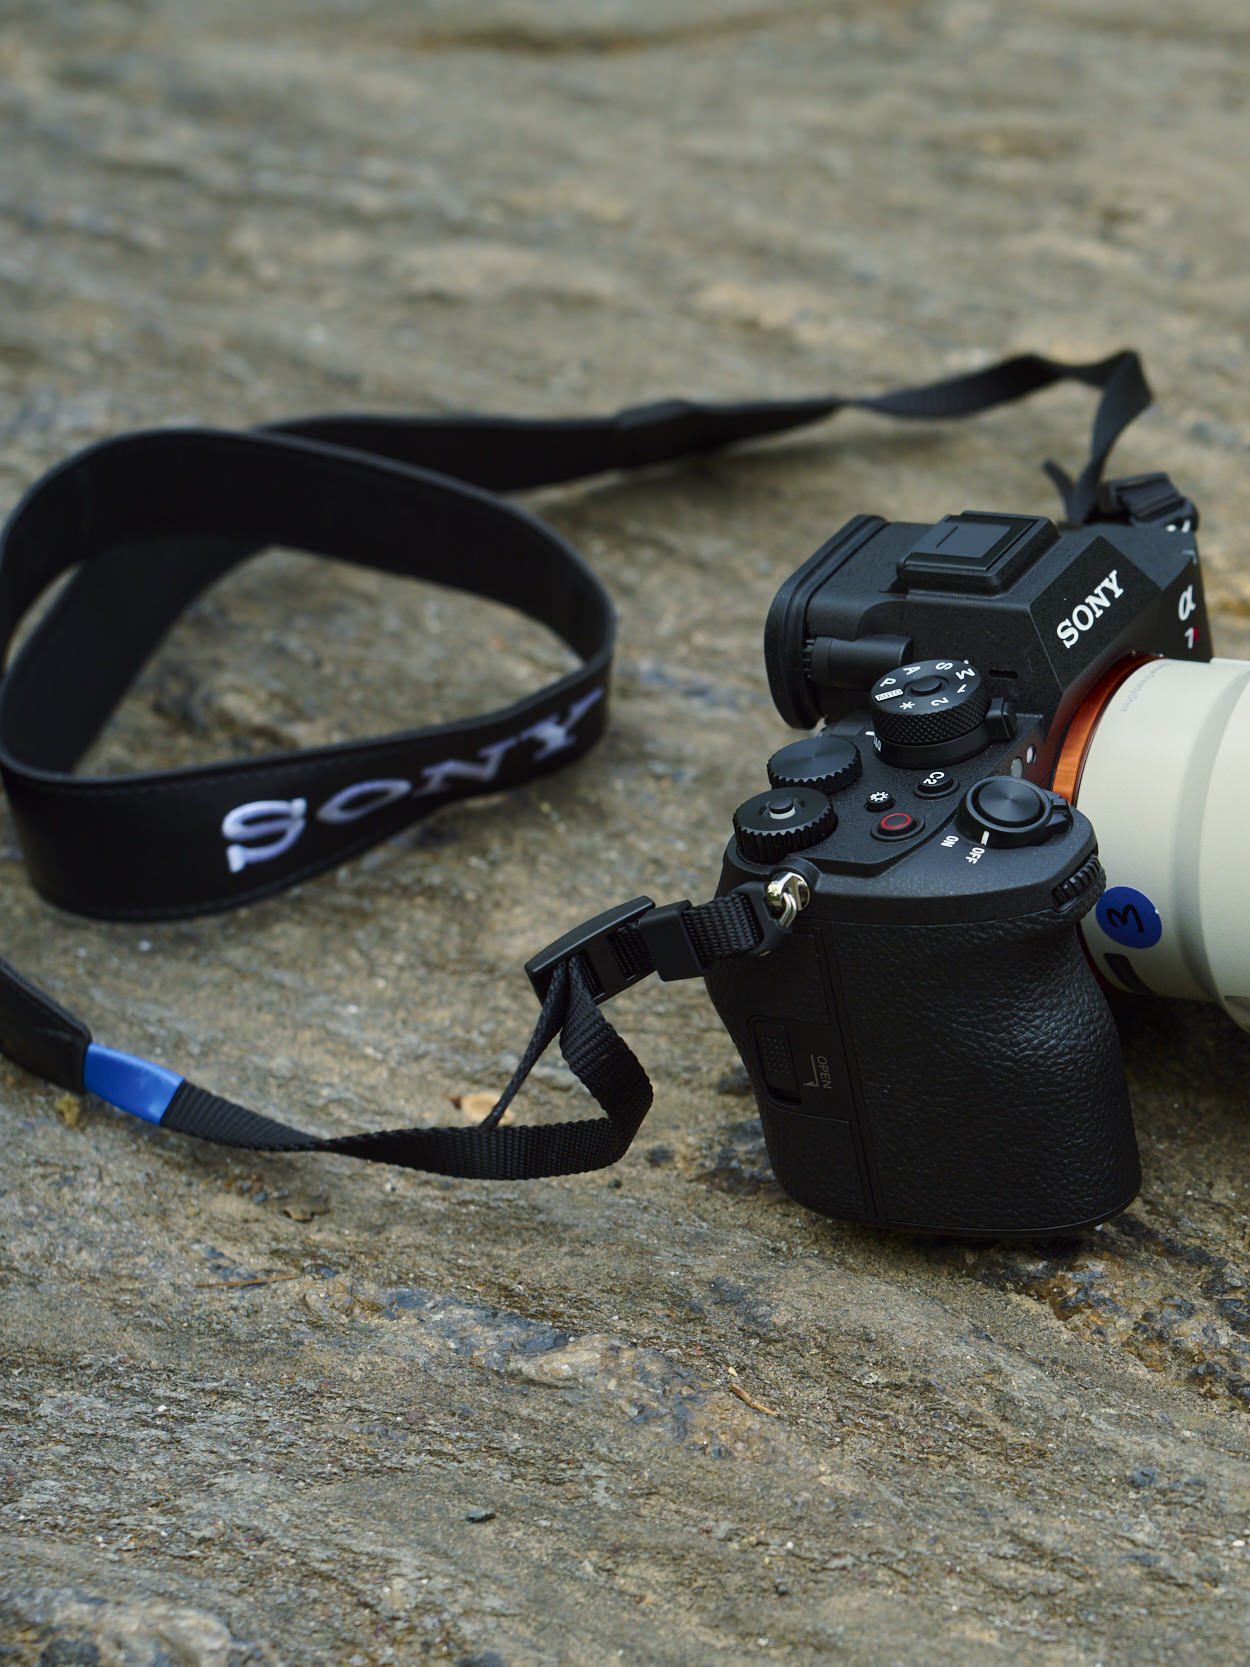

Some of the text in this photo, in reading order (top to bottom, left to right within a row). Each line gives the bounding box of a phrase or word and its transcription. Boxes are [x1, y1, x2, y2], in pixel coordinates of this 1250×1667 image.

[1056, 569, 1124, 649] SONY
[903, 666, 921, 676] A
[935, 661, 953, 670] S
[956, 668, 976, 680] M
[880, 677, 897, 687] P
[221, 686, 602, 873] SONY
[923, 771, 945, 785] C2
[940, 835, 960, 848] ON
[965, 847, 985, 865] OFF
[816, 1055, 833, 1089] OPEN
